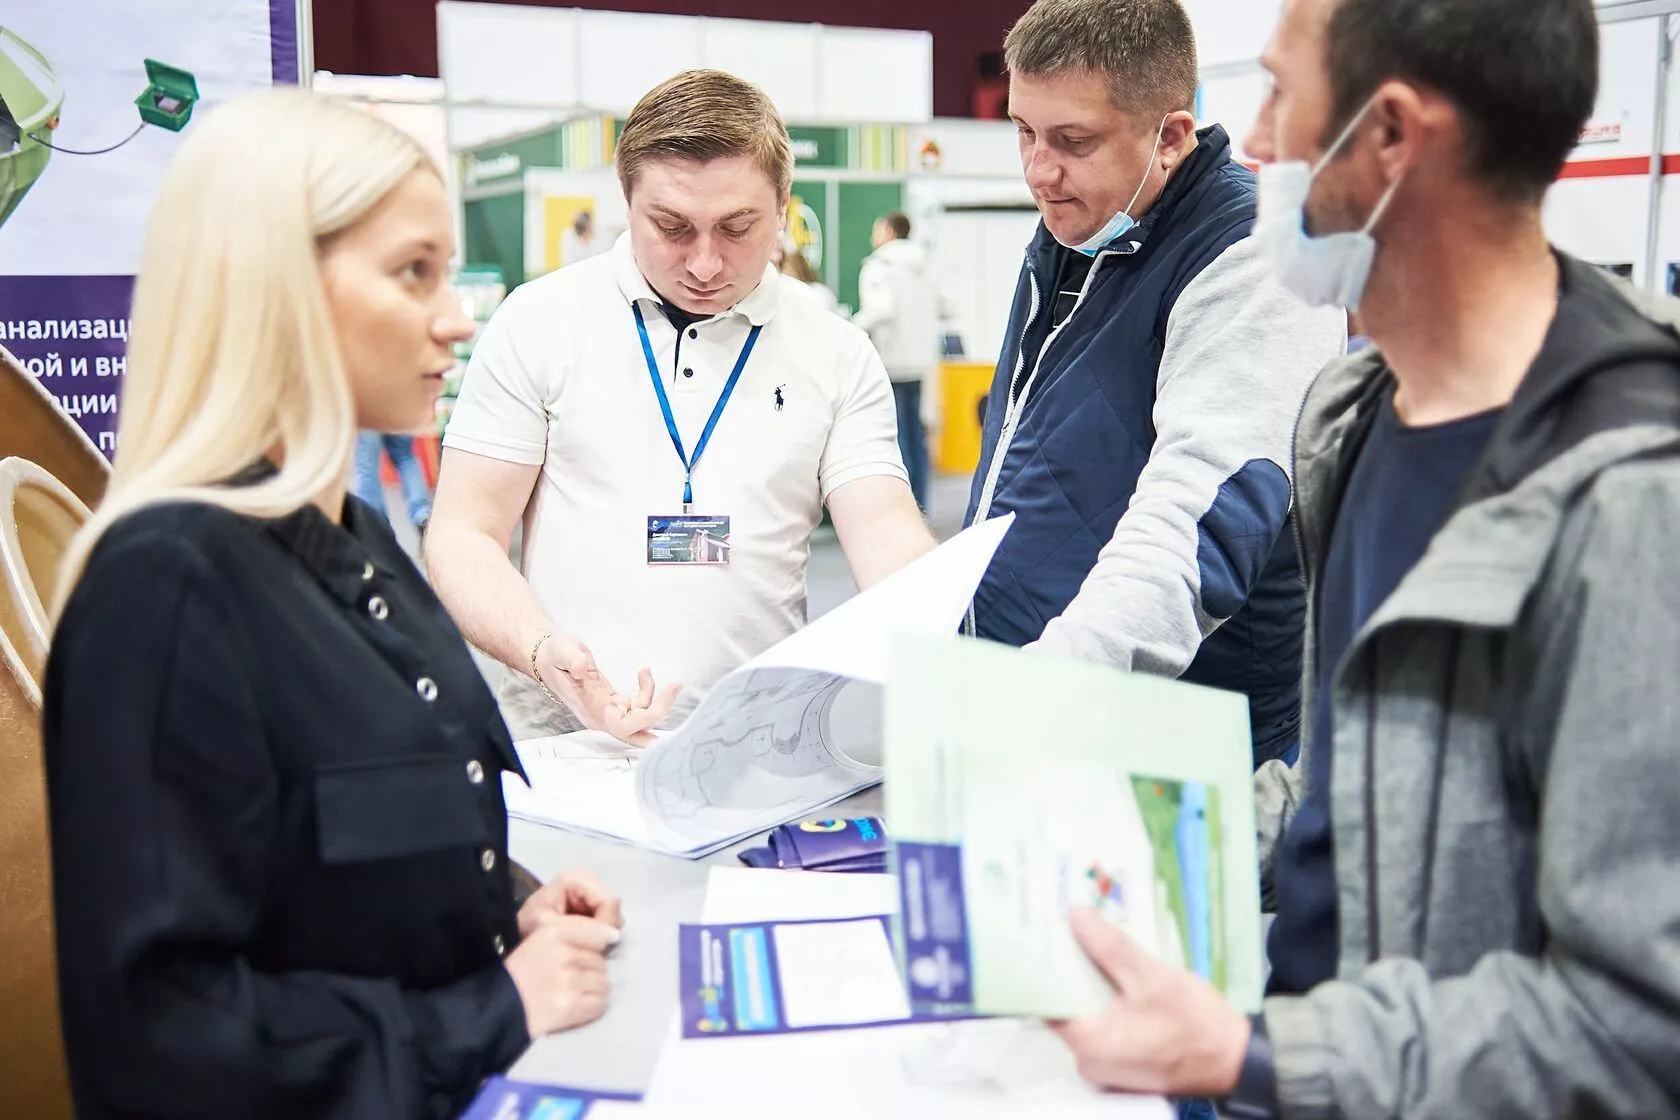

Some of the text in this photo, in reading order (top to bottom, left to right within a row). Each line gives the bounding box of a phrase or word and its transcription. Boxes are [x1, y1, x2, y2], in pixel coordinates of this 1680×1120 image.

[0, 319, 132, 342] нализац
[71, 357, 88, 376] и
[96, 356, 129, 376] вн
